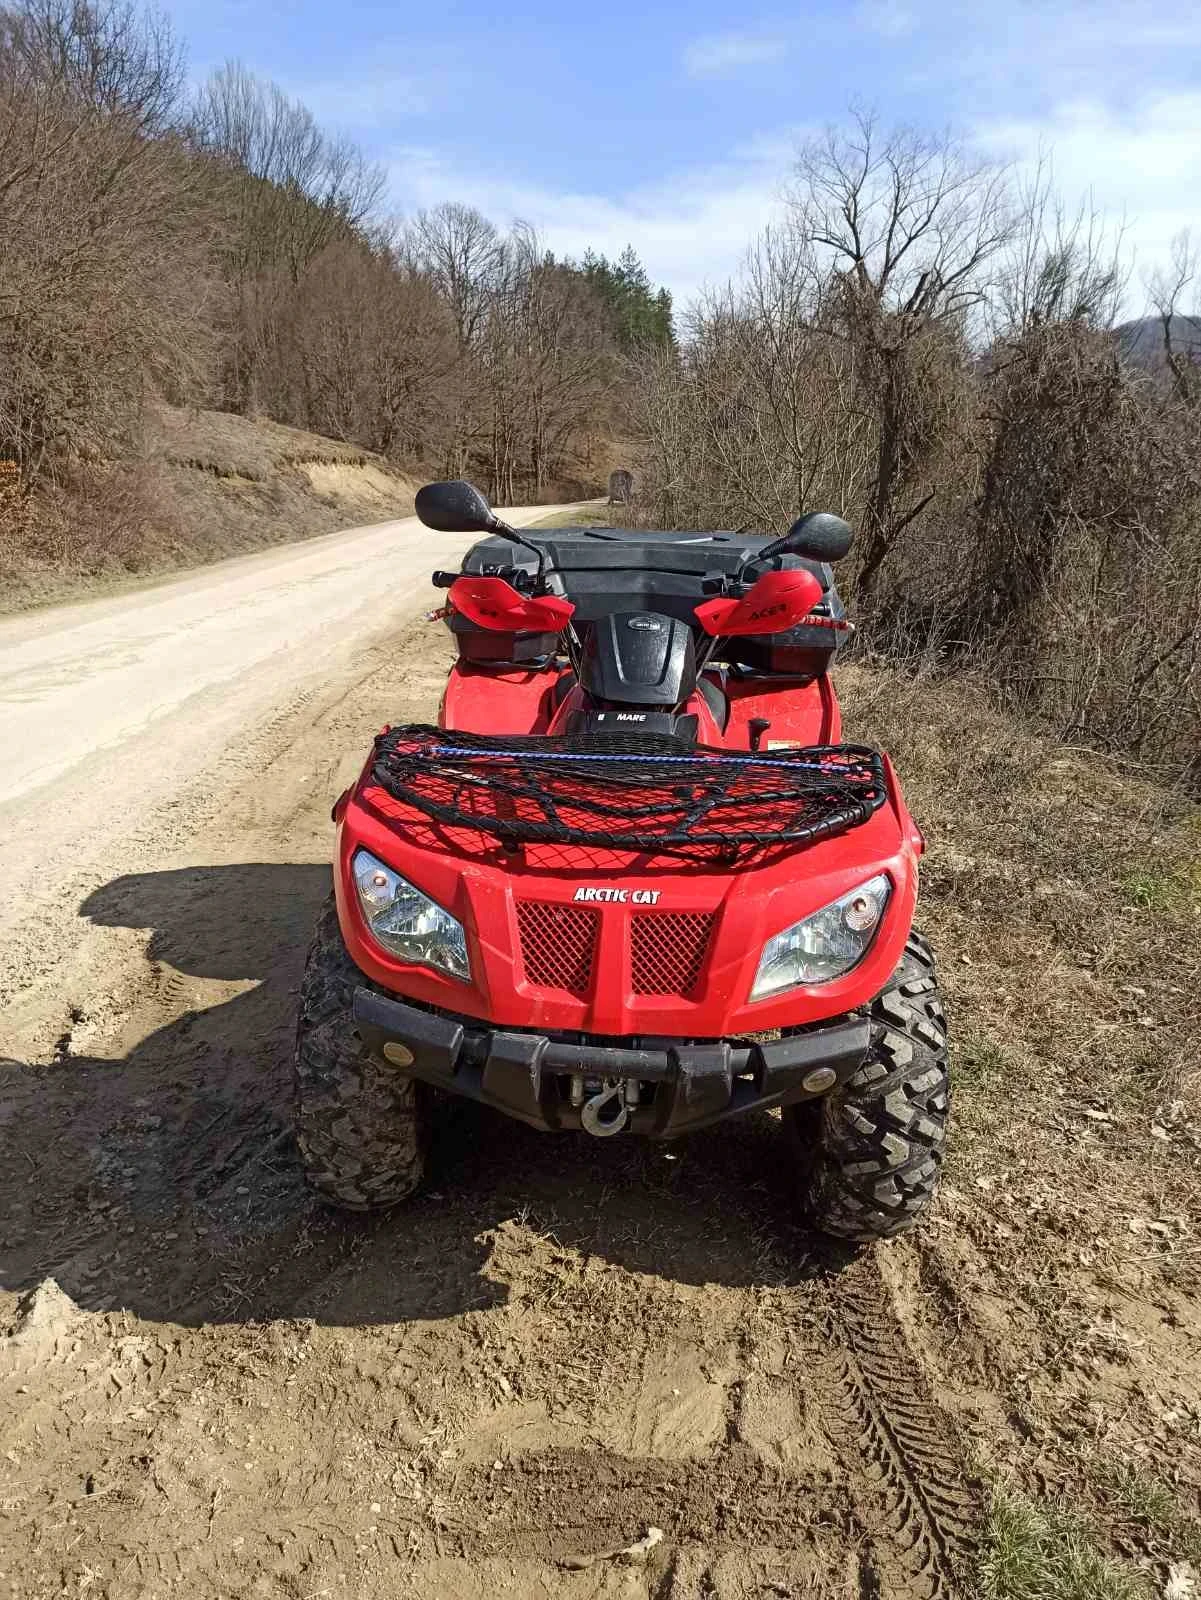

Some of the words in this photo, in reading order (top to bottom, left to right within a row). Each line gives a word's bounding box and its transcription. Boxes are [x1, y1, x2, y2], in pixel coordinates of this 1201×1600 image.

[616, 713, 647, 722] MARE
[573, 887, 629, 903] ARCTIC
[631, 889, 661, 905] CAT
